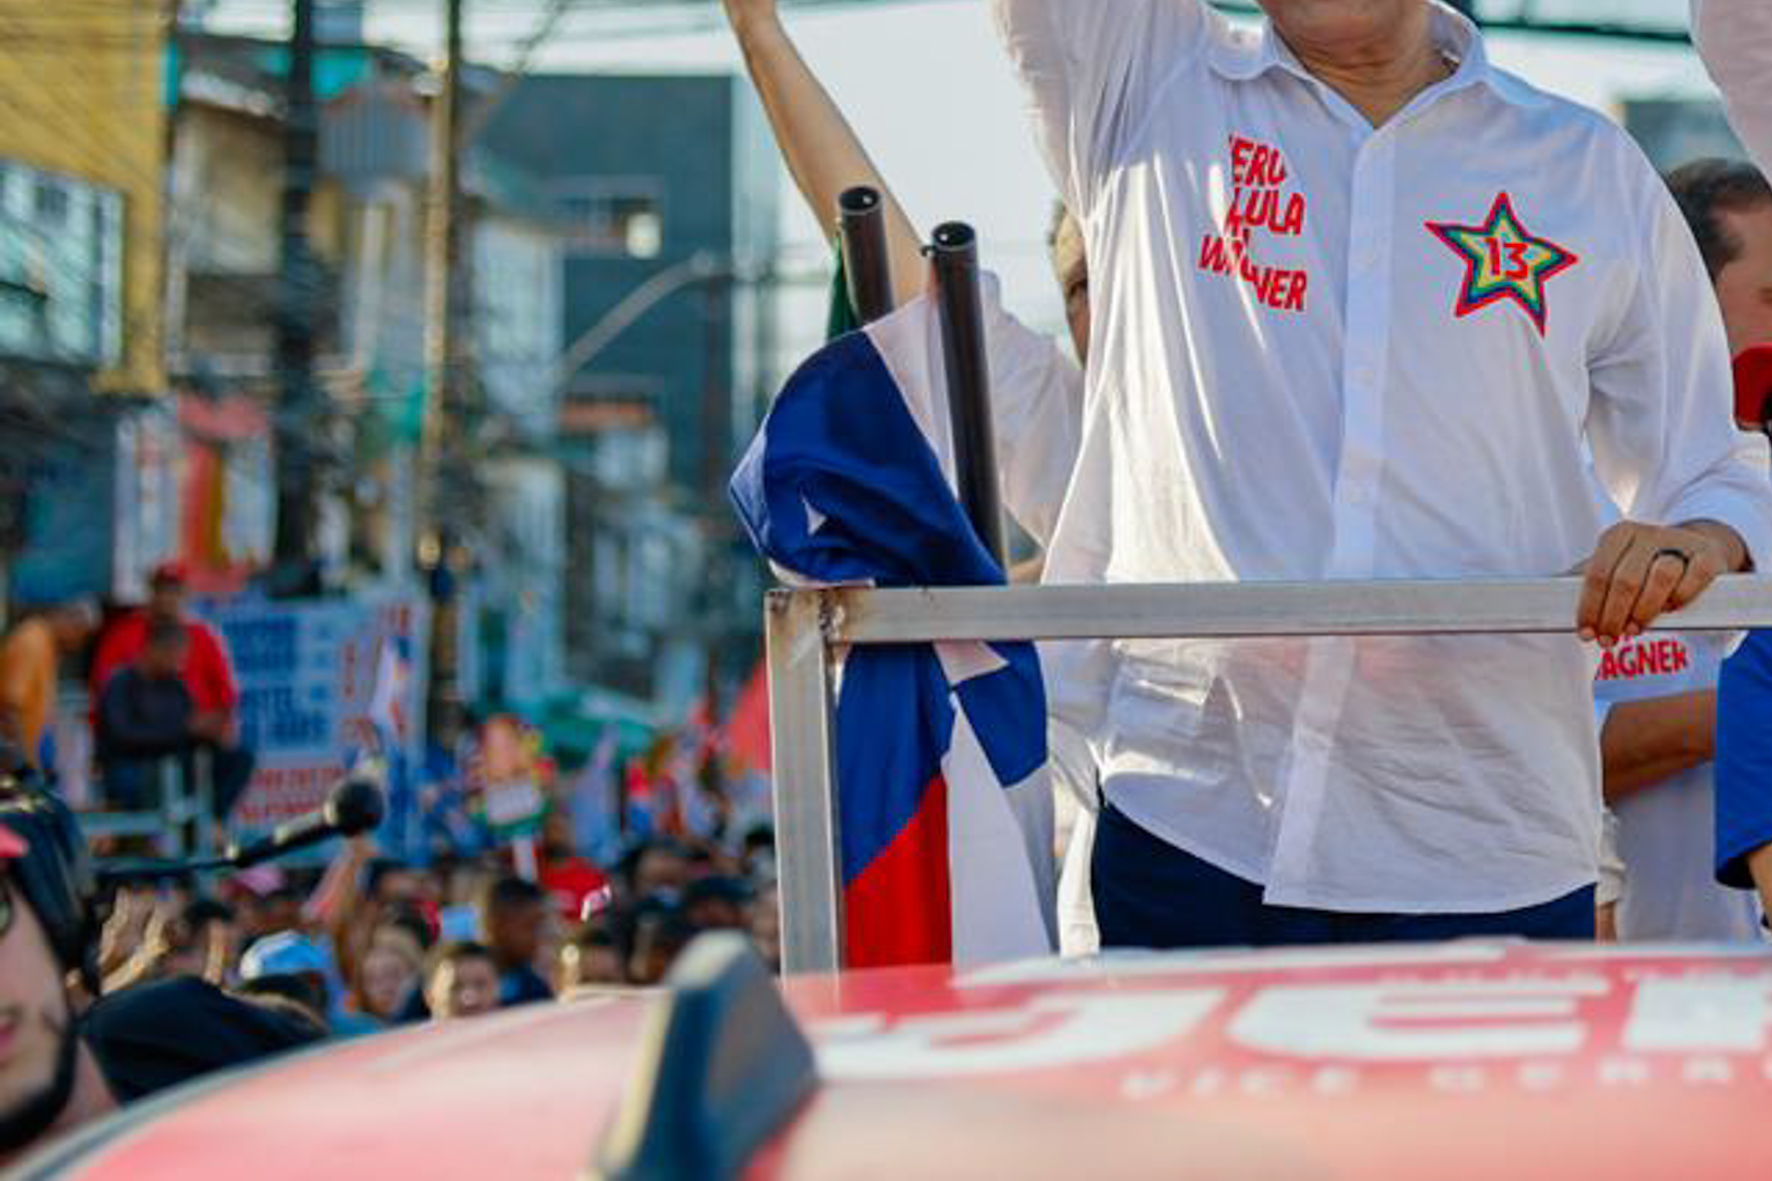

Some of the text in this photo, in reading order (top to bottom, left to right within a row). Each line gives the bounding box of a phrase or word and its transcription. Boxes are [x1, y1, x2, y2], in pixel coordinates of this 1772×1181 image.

[1484, 236, 1529, 280] 13
[1594, 640, 1688, 680] AGNER
[1121, 1063, 1359, 1099] VICE
